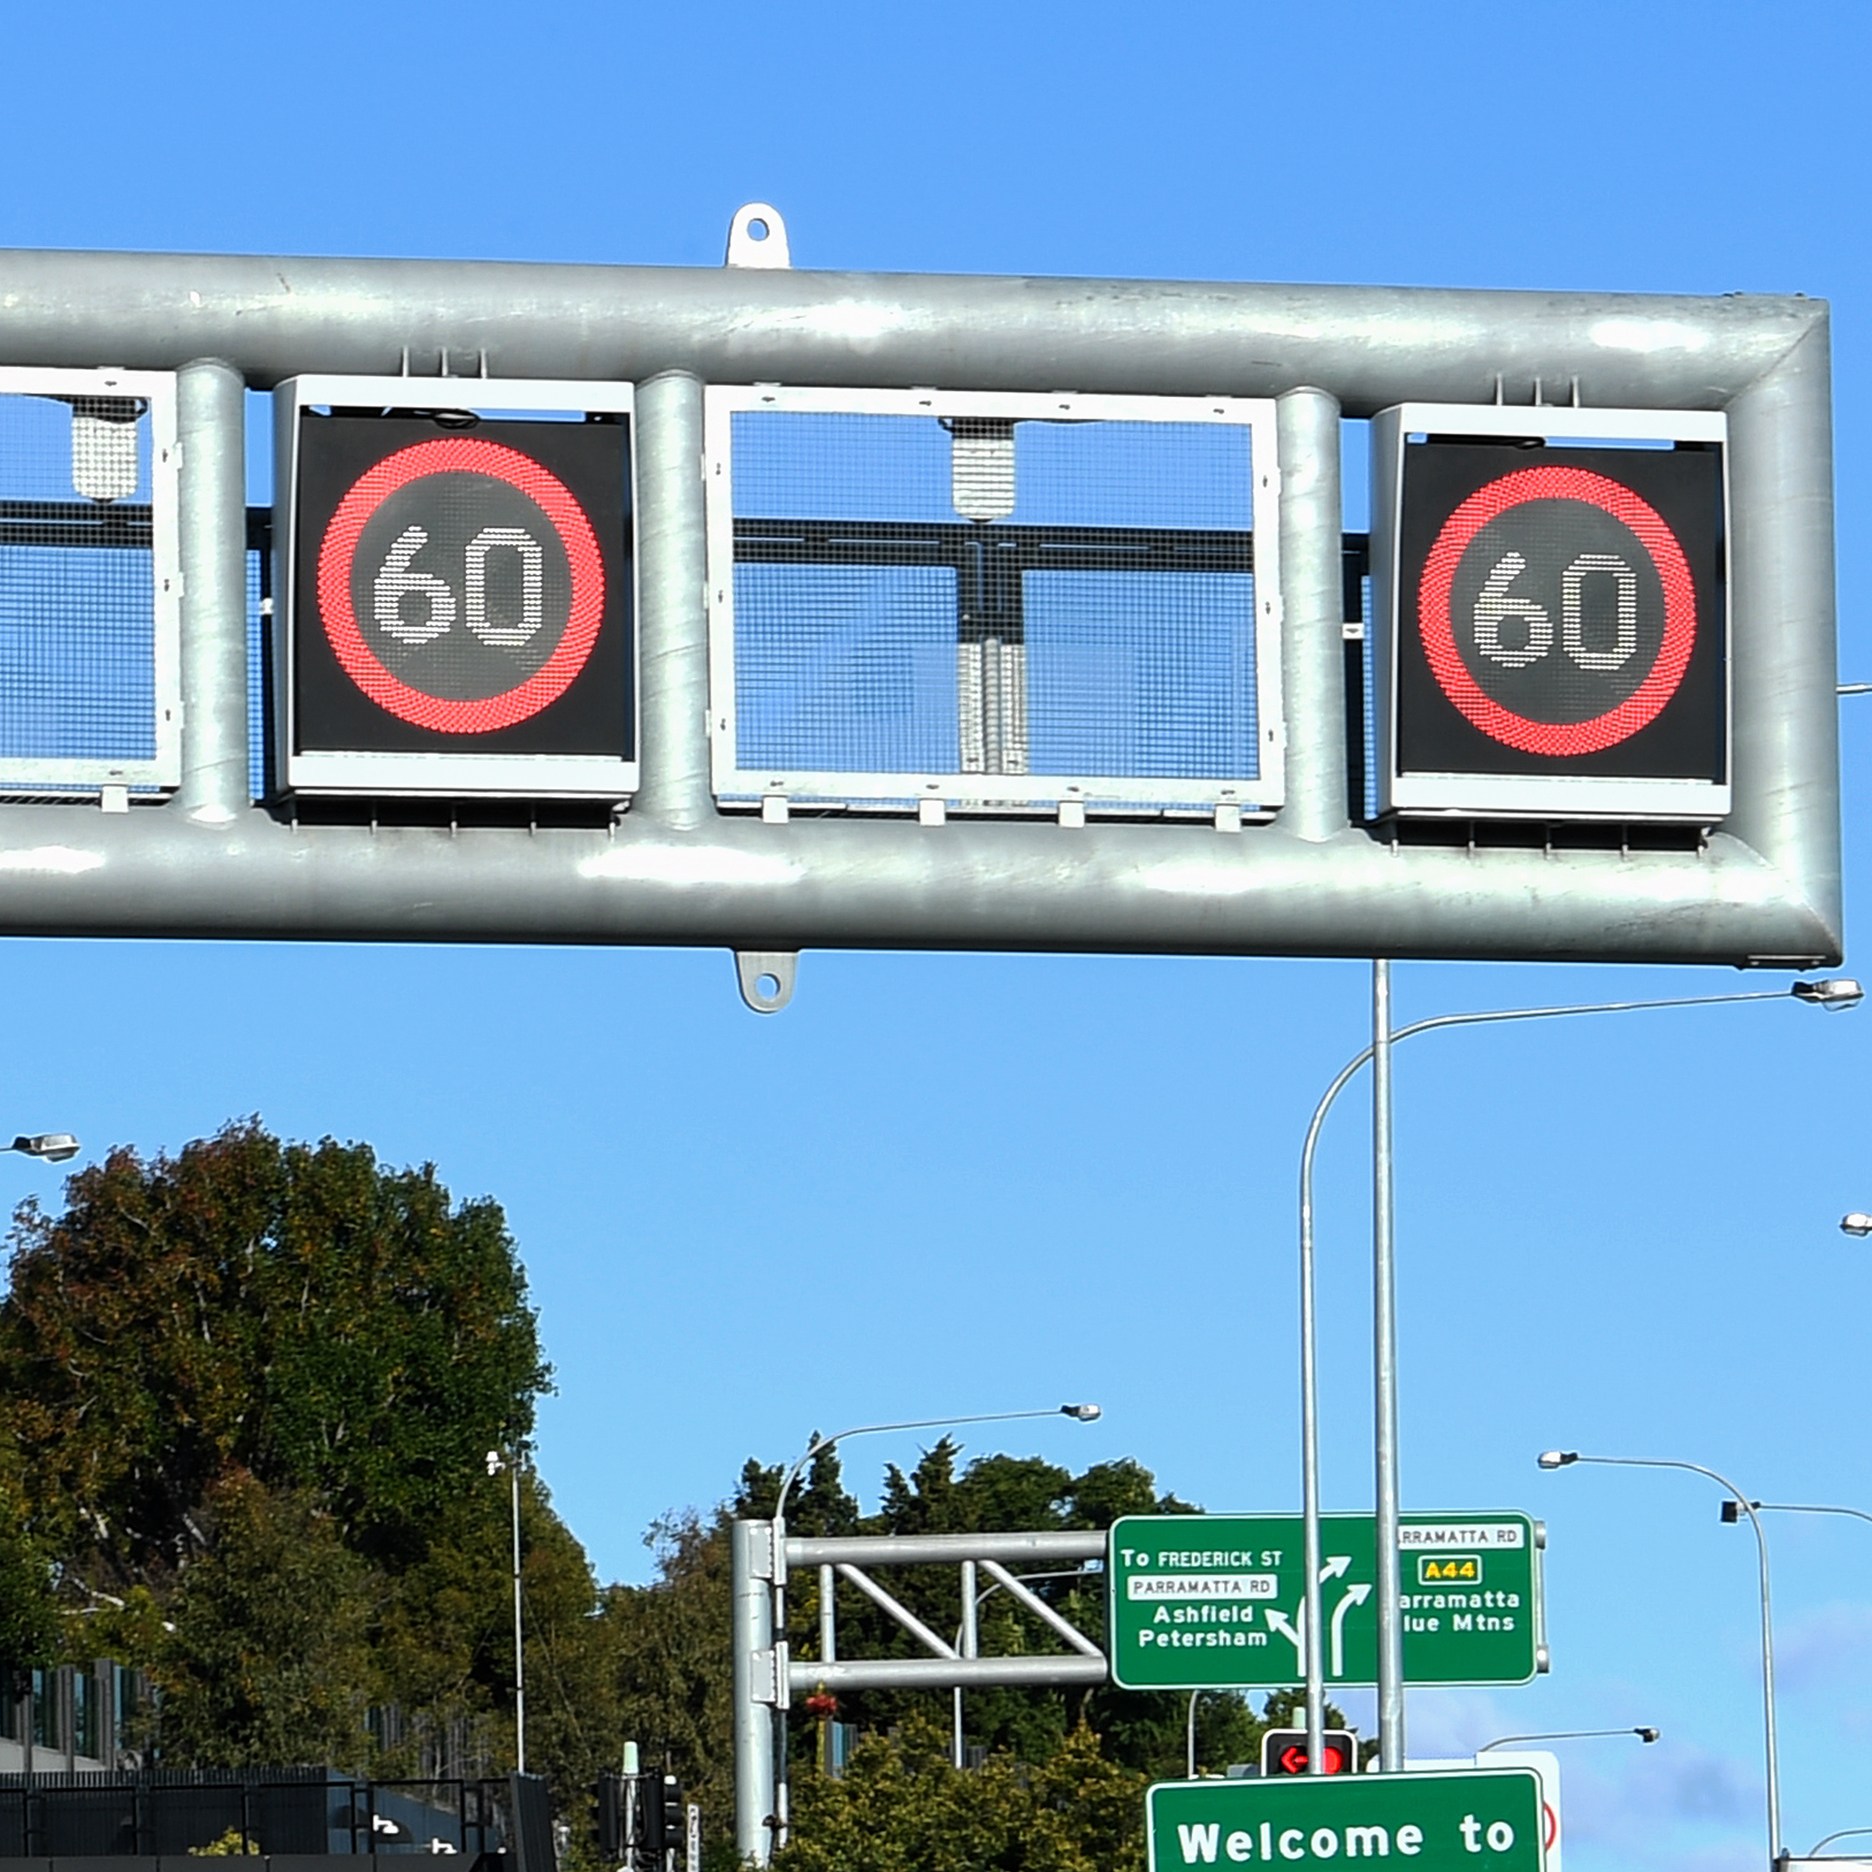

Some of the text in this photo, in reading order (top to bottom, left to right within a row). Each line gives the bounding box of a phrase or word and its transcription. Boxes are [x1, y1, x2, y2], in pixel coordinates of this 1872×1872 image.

[374, 526, 542, 644] 60
[1474, 552, 1637, 670] 60
[1398, 1529, 1517, 1543] RRAMATTA RD
[1120, 1549, 1283, 1568] To FREDERICK ST
[1425, 1561, 1476, 1578] A44
[1133, 1580, 1271, 1594] PARRAMATTA RD
[1398, 1591, 1520, 1609] arramatta
[1153, 1605, 1253, 1624] Ashfield
[1403, 1613, 1515, 1632] lue Mtns
[1139, 1629, 1268, 1647] Petersham
[1177, 1814, 1515, 1864] Welcome to
